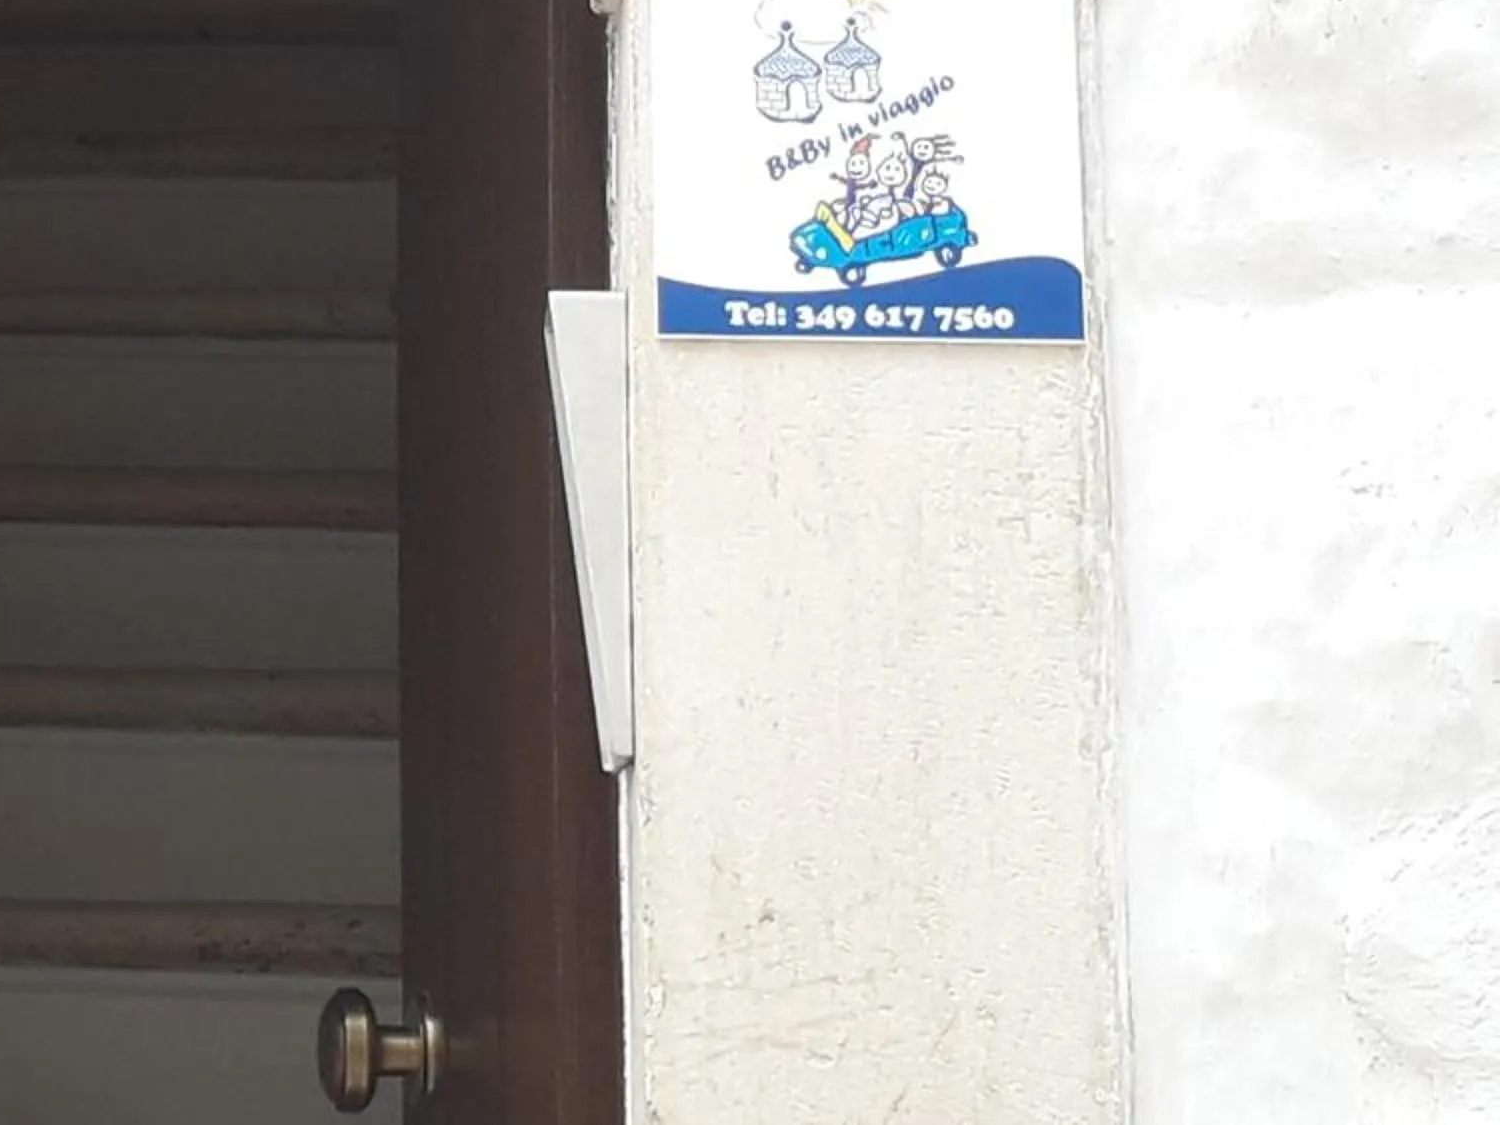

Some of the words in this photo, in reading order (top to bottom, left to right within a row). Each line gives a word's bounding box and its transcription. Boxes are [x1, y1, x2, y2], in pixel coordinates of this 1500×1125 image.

[766, 135, 831, 181] B&By
[838, 122, 863, 142] in
[868, 75, 955, 127] viaggio
[724, 300, 788, 328] Tel:
[794, 304, 857, 331] 349
[864, 304, 924, 330] 617
[933, 305, 1015, 331] 7560
